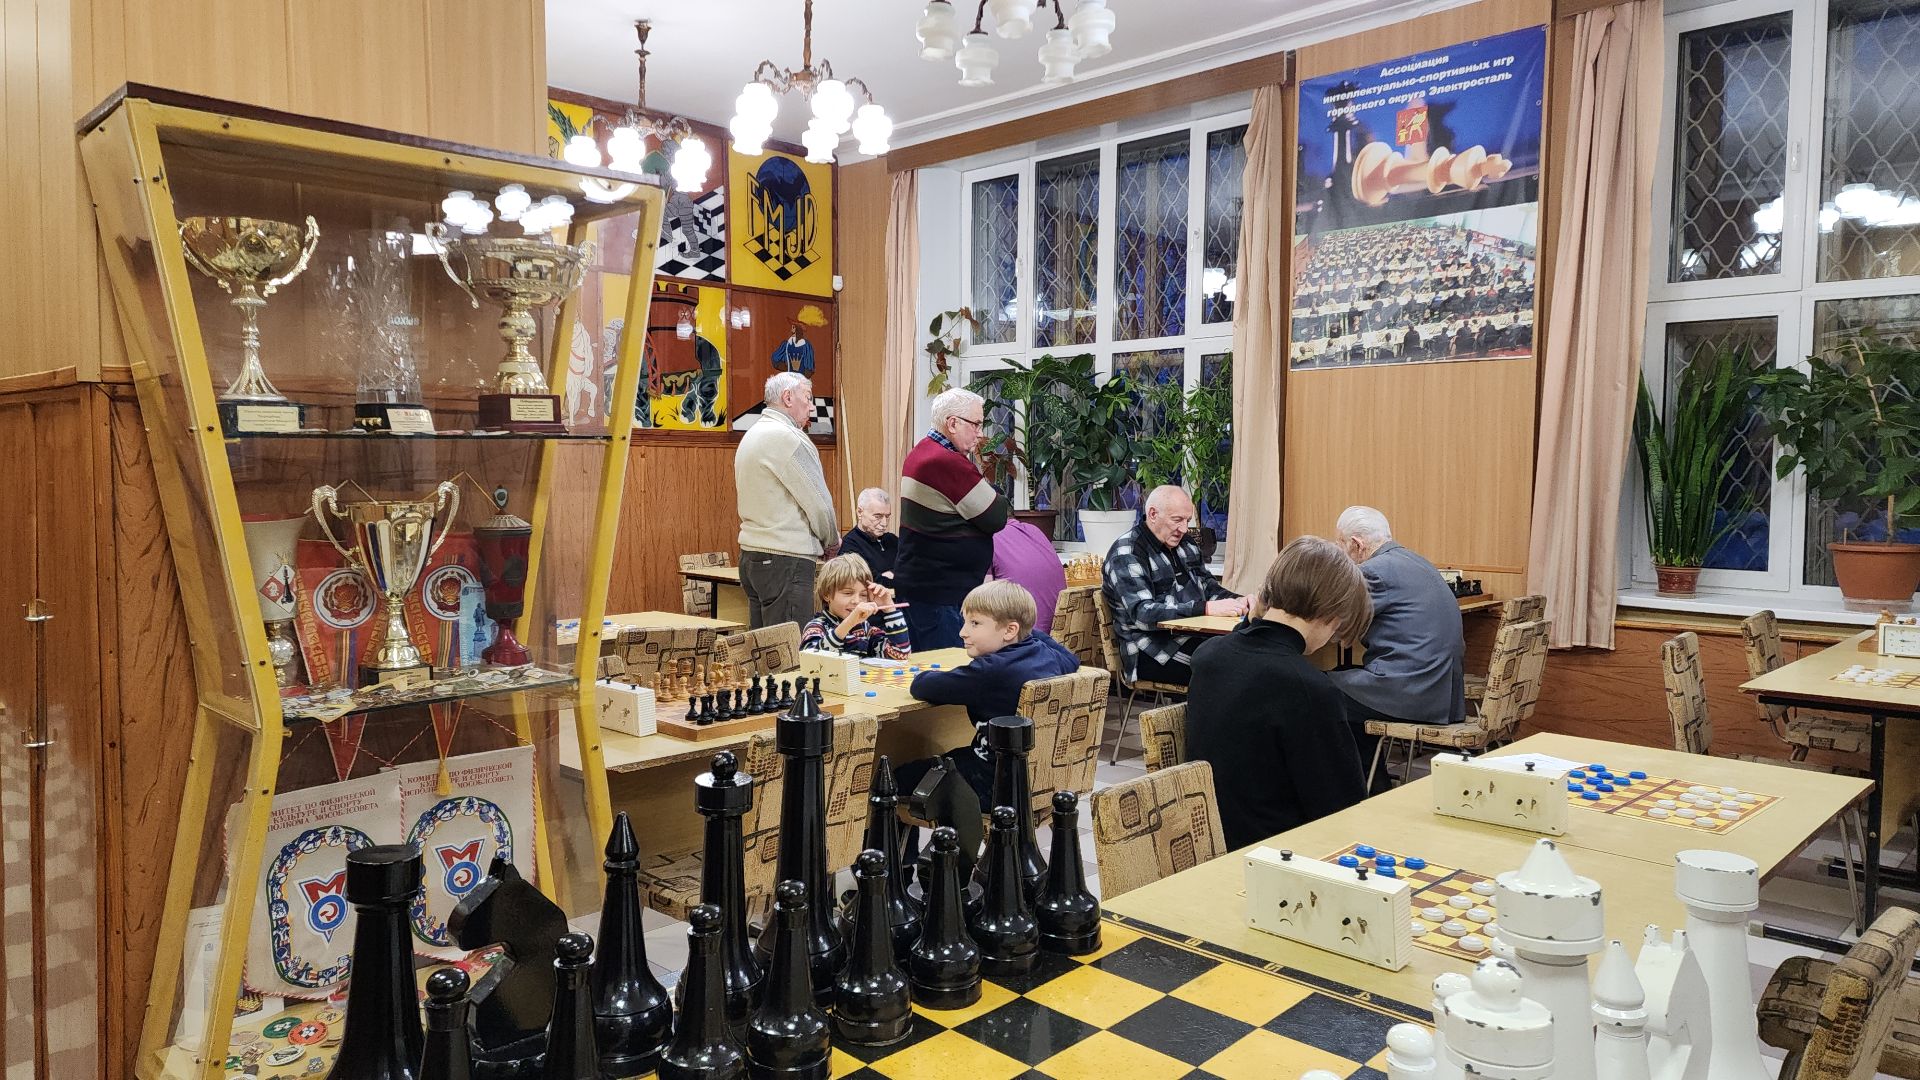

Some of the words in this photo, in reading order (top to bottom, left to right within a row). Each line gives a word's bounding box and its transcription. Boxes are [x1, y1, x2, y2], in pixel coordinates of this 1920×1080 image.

[1379, 54, 1450, 78] Ассоциация
[1322, 60, 1491, 104] интеллектуально-спортивных
[1493, 55, 1515, 71] игр
[1326, 98, 1386, 118] городского
[1388, 89, 1426, 106] округа
[1428, 71, 1513, 96] Электросталь
[746, 171, 819, 266] FMJD
[448, 770, 460, 778] ПО
[461, 761, 512, 775] ФИЗИЧЕСКОЙ
[470, 771, 499, 780] СПОРТУ
[305, 801, 317, 810] ПО
[319, 788, 376, 806] ФИЗИЧЕСКОЙ
[273, 809, 316, 824] КУЛЬТУРЕ
[329, 799, 362, 812] СПОРТУ
